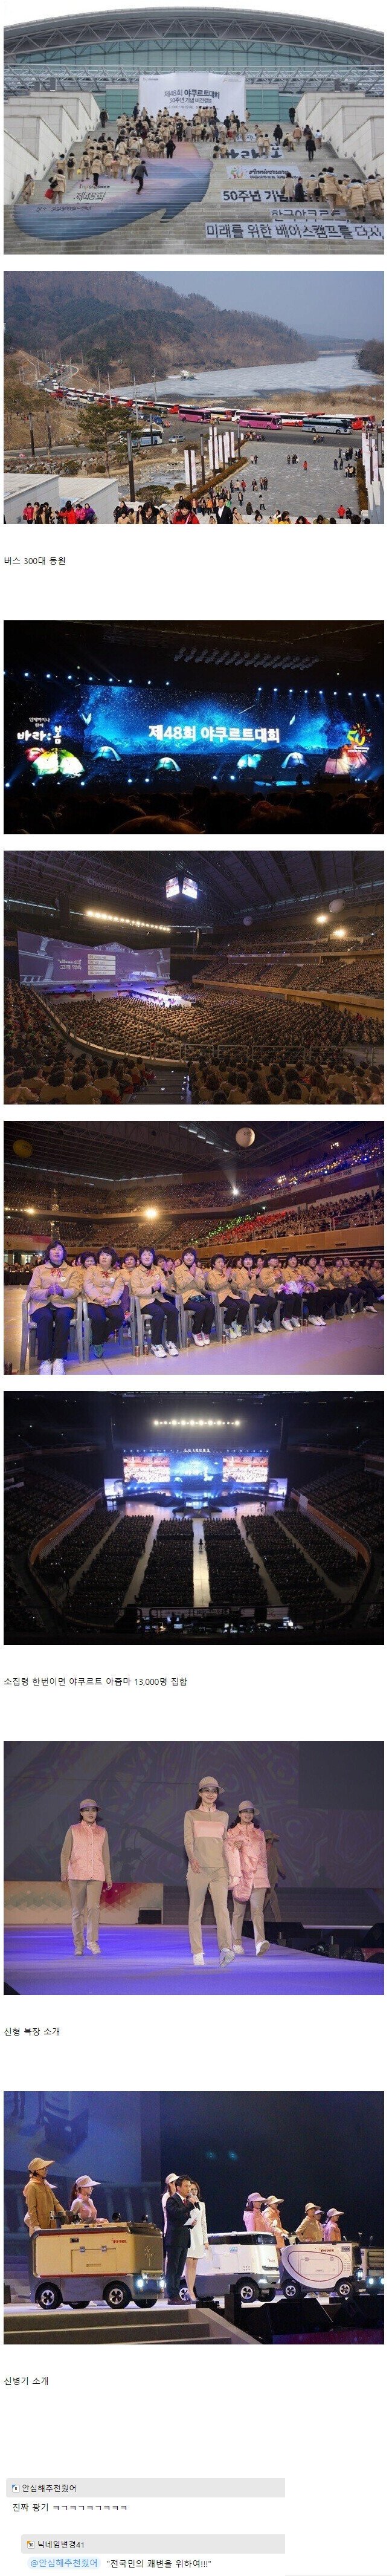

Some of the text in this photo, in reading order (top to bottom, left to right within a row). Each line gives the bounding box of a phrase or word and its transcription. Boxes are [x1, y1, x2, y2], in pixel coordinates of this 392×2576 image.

[184, 89, 220, 99] 야쿠르트대회
[223, 190, 262, 202] 50주년
[206, 224, 243, 238] 미래를
[248, 224, 272, 238] 위한
[275, 224, 353, 239] 베이스캠프를
[149, 724, 280, 743] 제48회 야쿠르트대회
